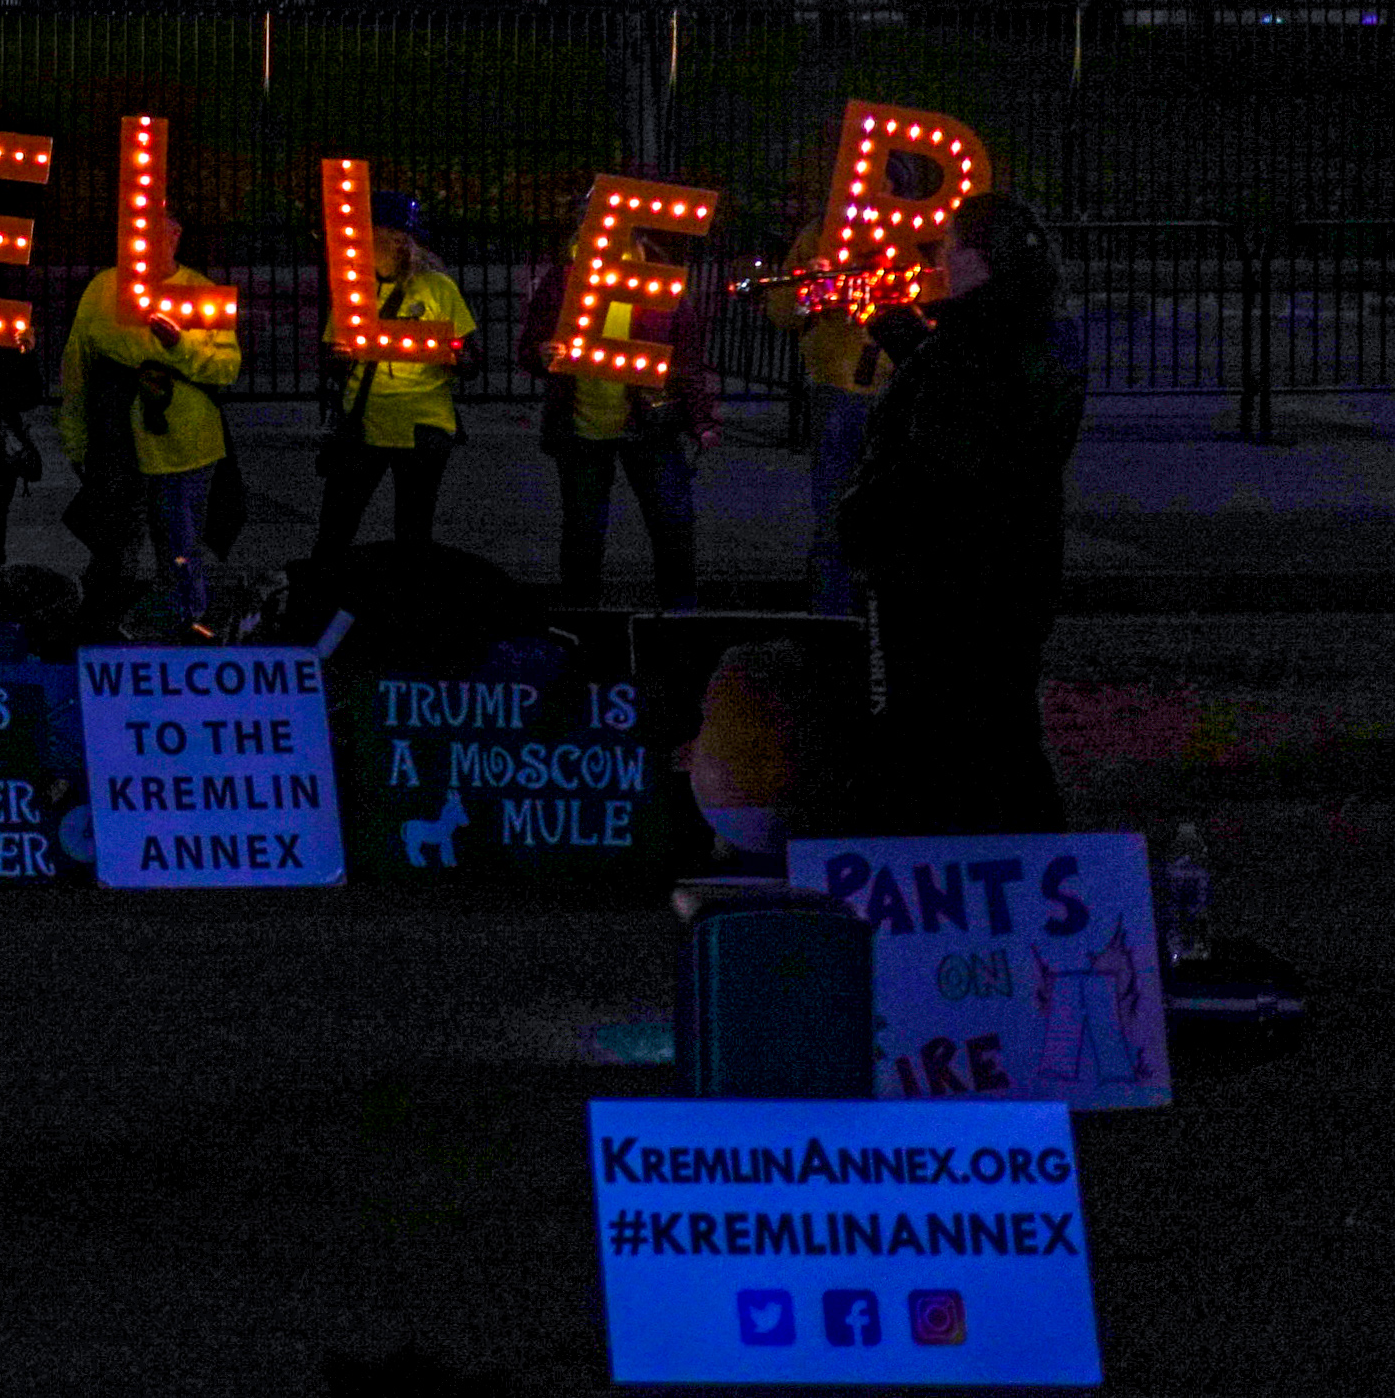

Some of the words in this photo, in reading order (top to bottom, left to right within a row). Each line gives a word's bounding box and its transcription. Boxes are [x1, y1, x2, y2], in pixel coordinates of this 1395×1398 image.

[86, 659, 320, 697] WELCOME
[378, 679, 539, 730] TRUMP
[587, 682, 639, 730] IS
[125, 720, 187, 756] TO
[202, 719, 294, 755] THE
[387, 738, 421, 787] A
[448, 741, 646, 792] MOSCOW
[109, 774, 321, 812] KREMLIN
[502, 797, 634, 848] MULE
[140, 835, 303, 871] ANNEX
[825, 852, 1090, 936] PANTS
[609, 1210, 1077, 1256] #KREMLINANNEX
